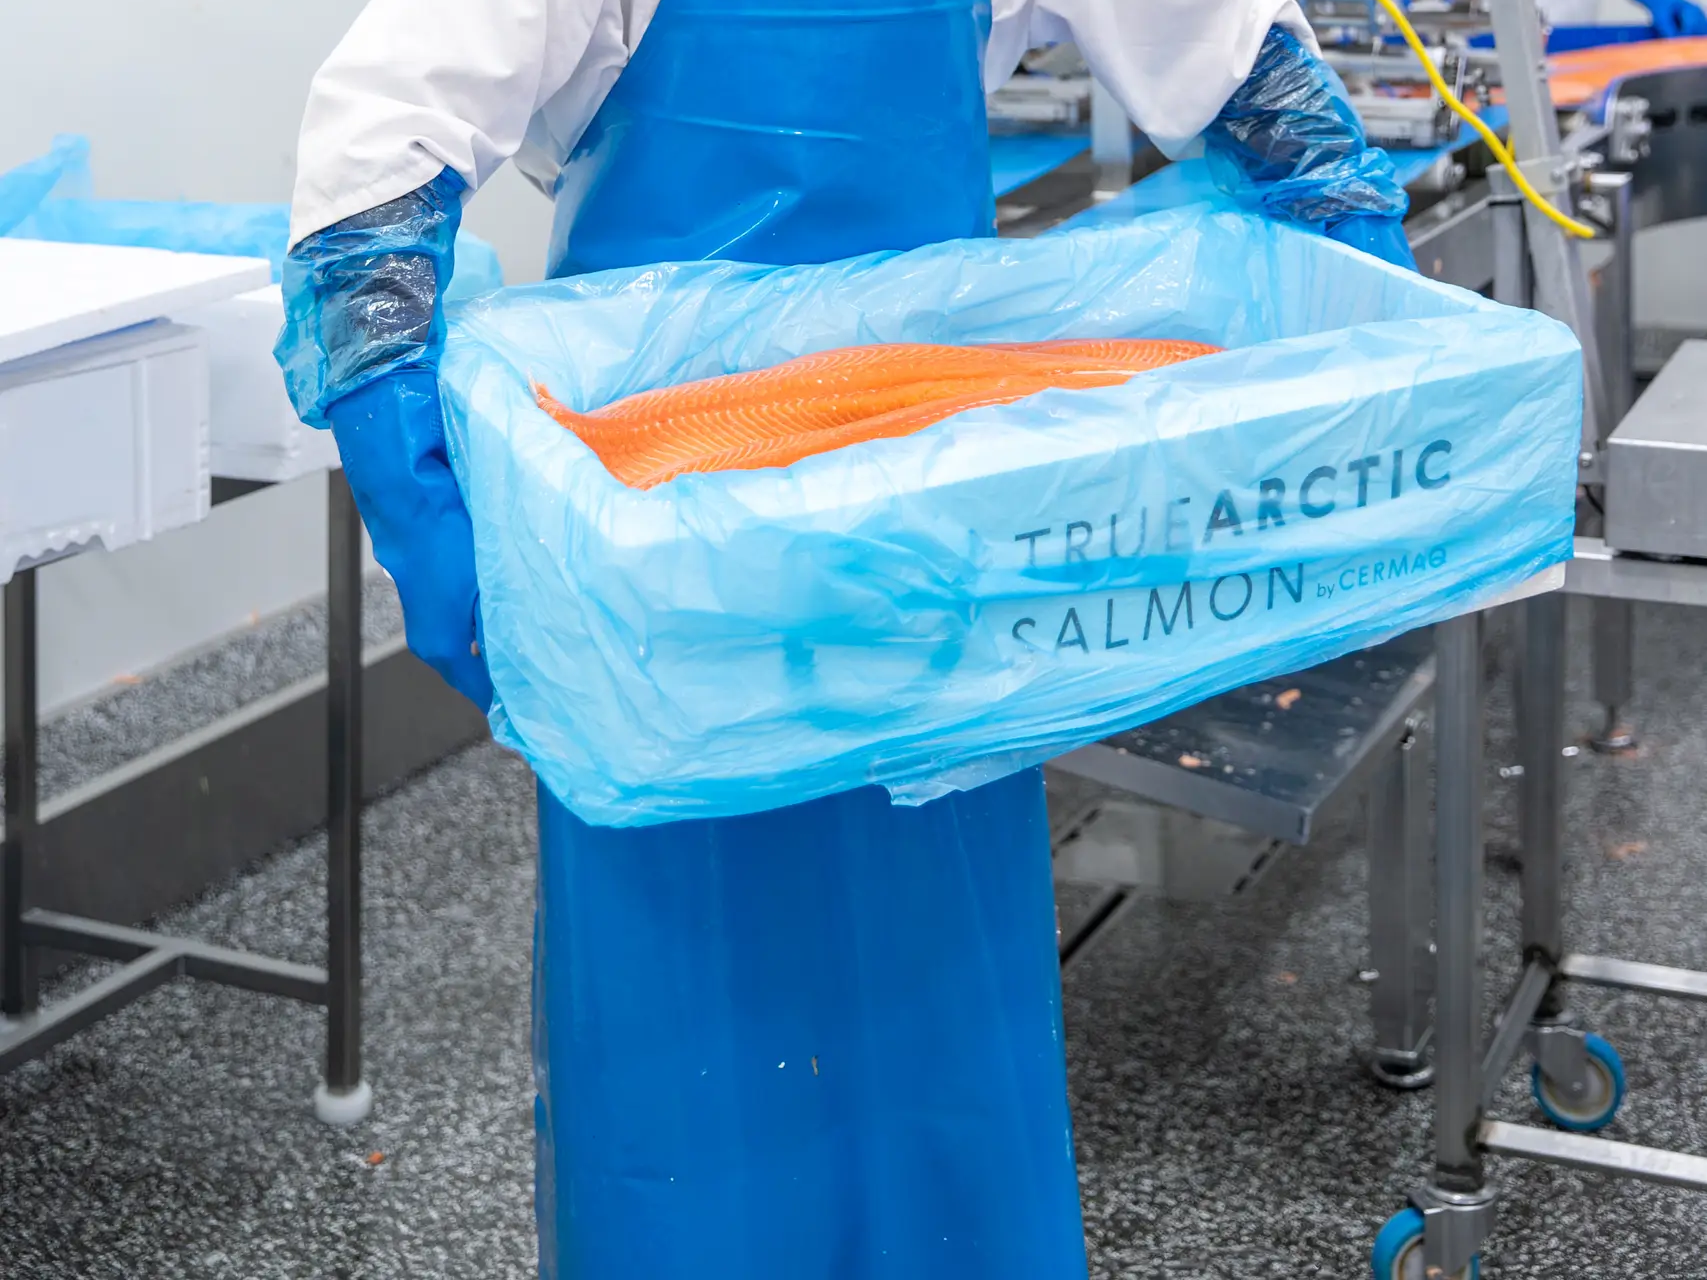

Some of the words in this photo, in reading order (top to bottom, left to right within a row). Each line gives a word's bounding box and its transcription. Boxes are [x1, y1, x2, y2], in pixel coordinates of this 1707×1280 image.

[1012, 562, 1304, 655] SALMON
[1316, 583, 1335, 599] by
[1339, 545, 1447, 591] CERMAQ
